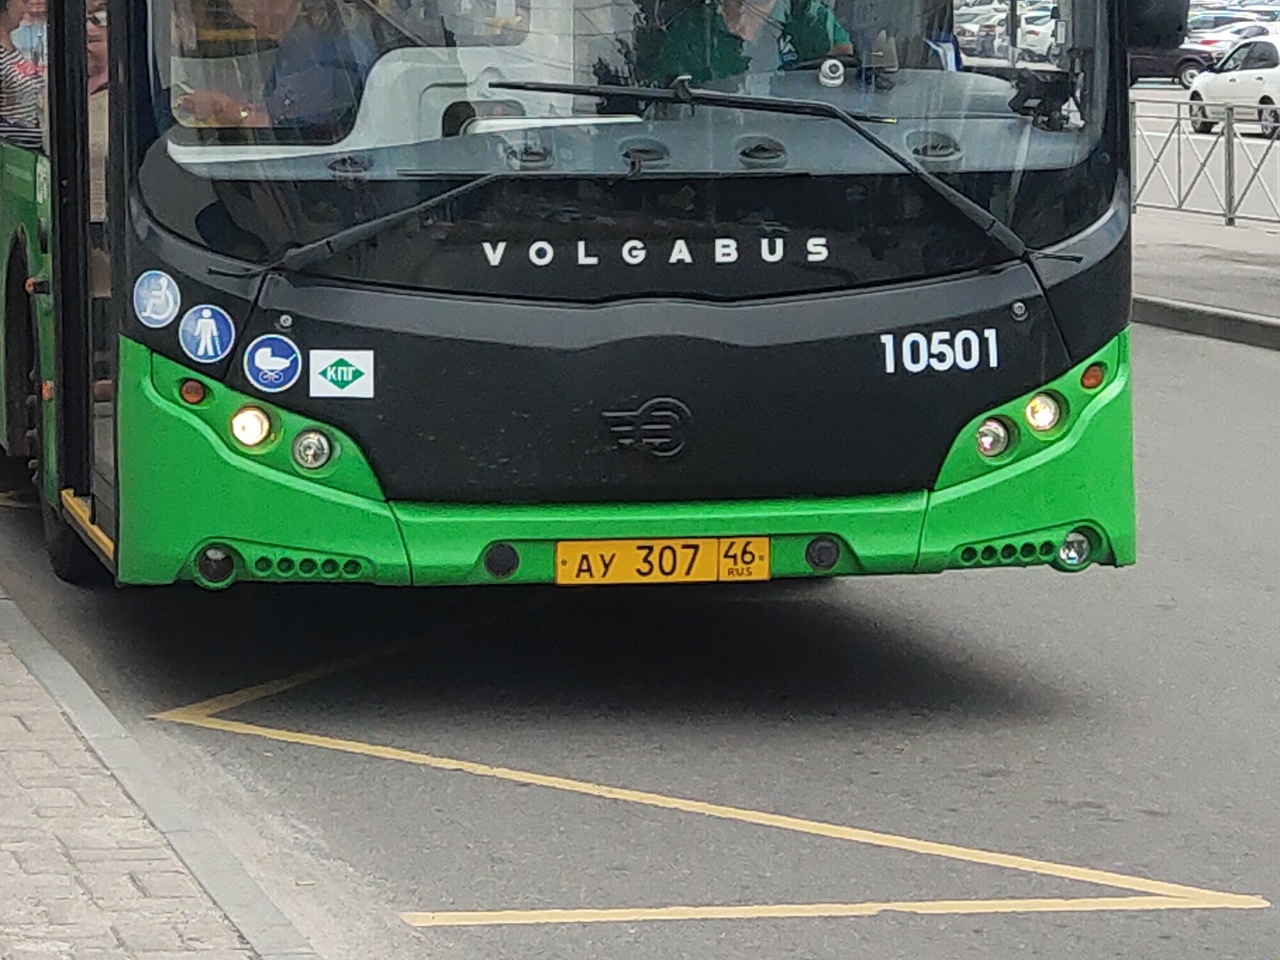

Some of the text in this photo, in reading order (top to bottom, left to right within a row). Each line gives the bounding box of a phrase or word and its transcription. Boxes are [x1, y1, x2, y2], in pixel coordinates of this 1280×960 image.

[482, 237, 829, 267] VOLGABUS
[880, 328, 998, 374] 10501
[326, 365, 357, 382] КПГ
[575, 540, 756, 579] АУ 307 46
[727, 566, 753, 578] RUS
